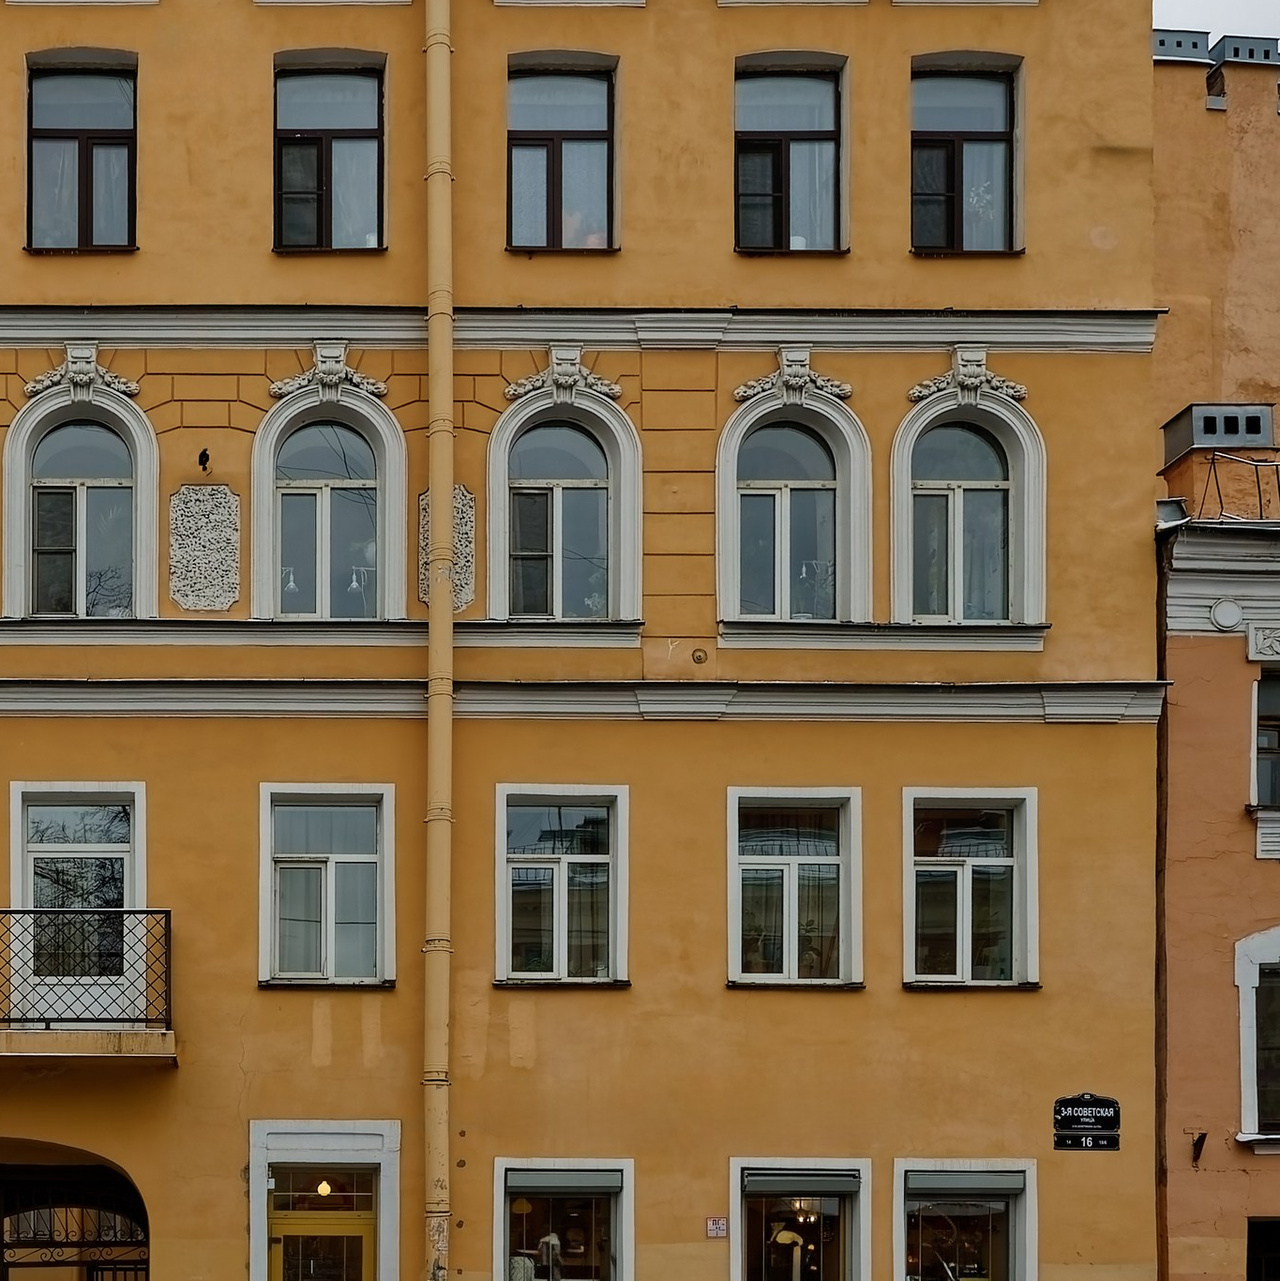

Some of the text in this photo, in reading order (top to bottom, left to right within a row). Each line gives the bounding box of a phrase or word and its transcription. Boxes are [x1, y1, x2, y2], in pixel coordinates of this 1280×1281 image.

[1061, 1107, 1114, 1116] 3-Я СОВЕТСКАЯ
[1081, 1137, 1092, 1147] 16
